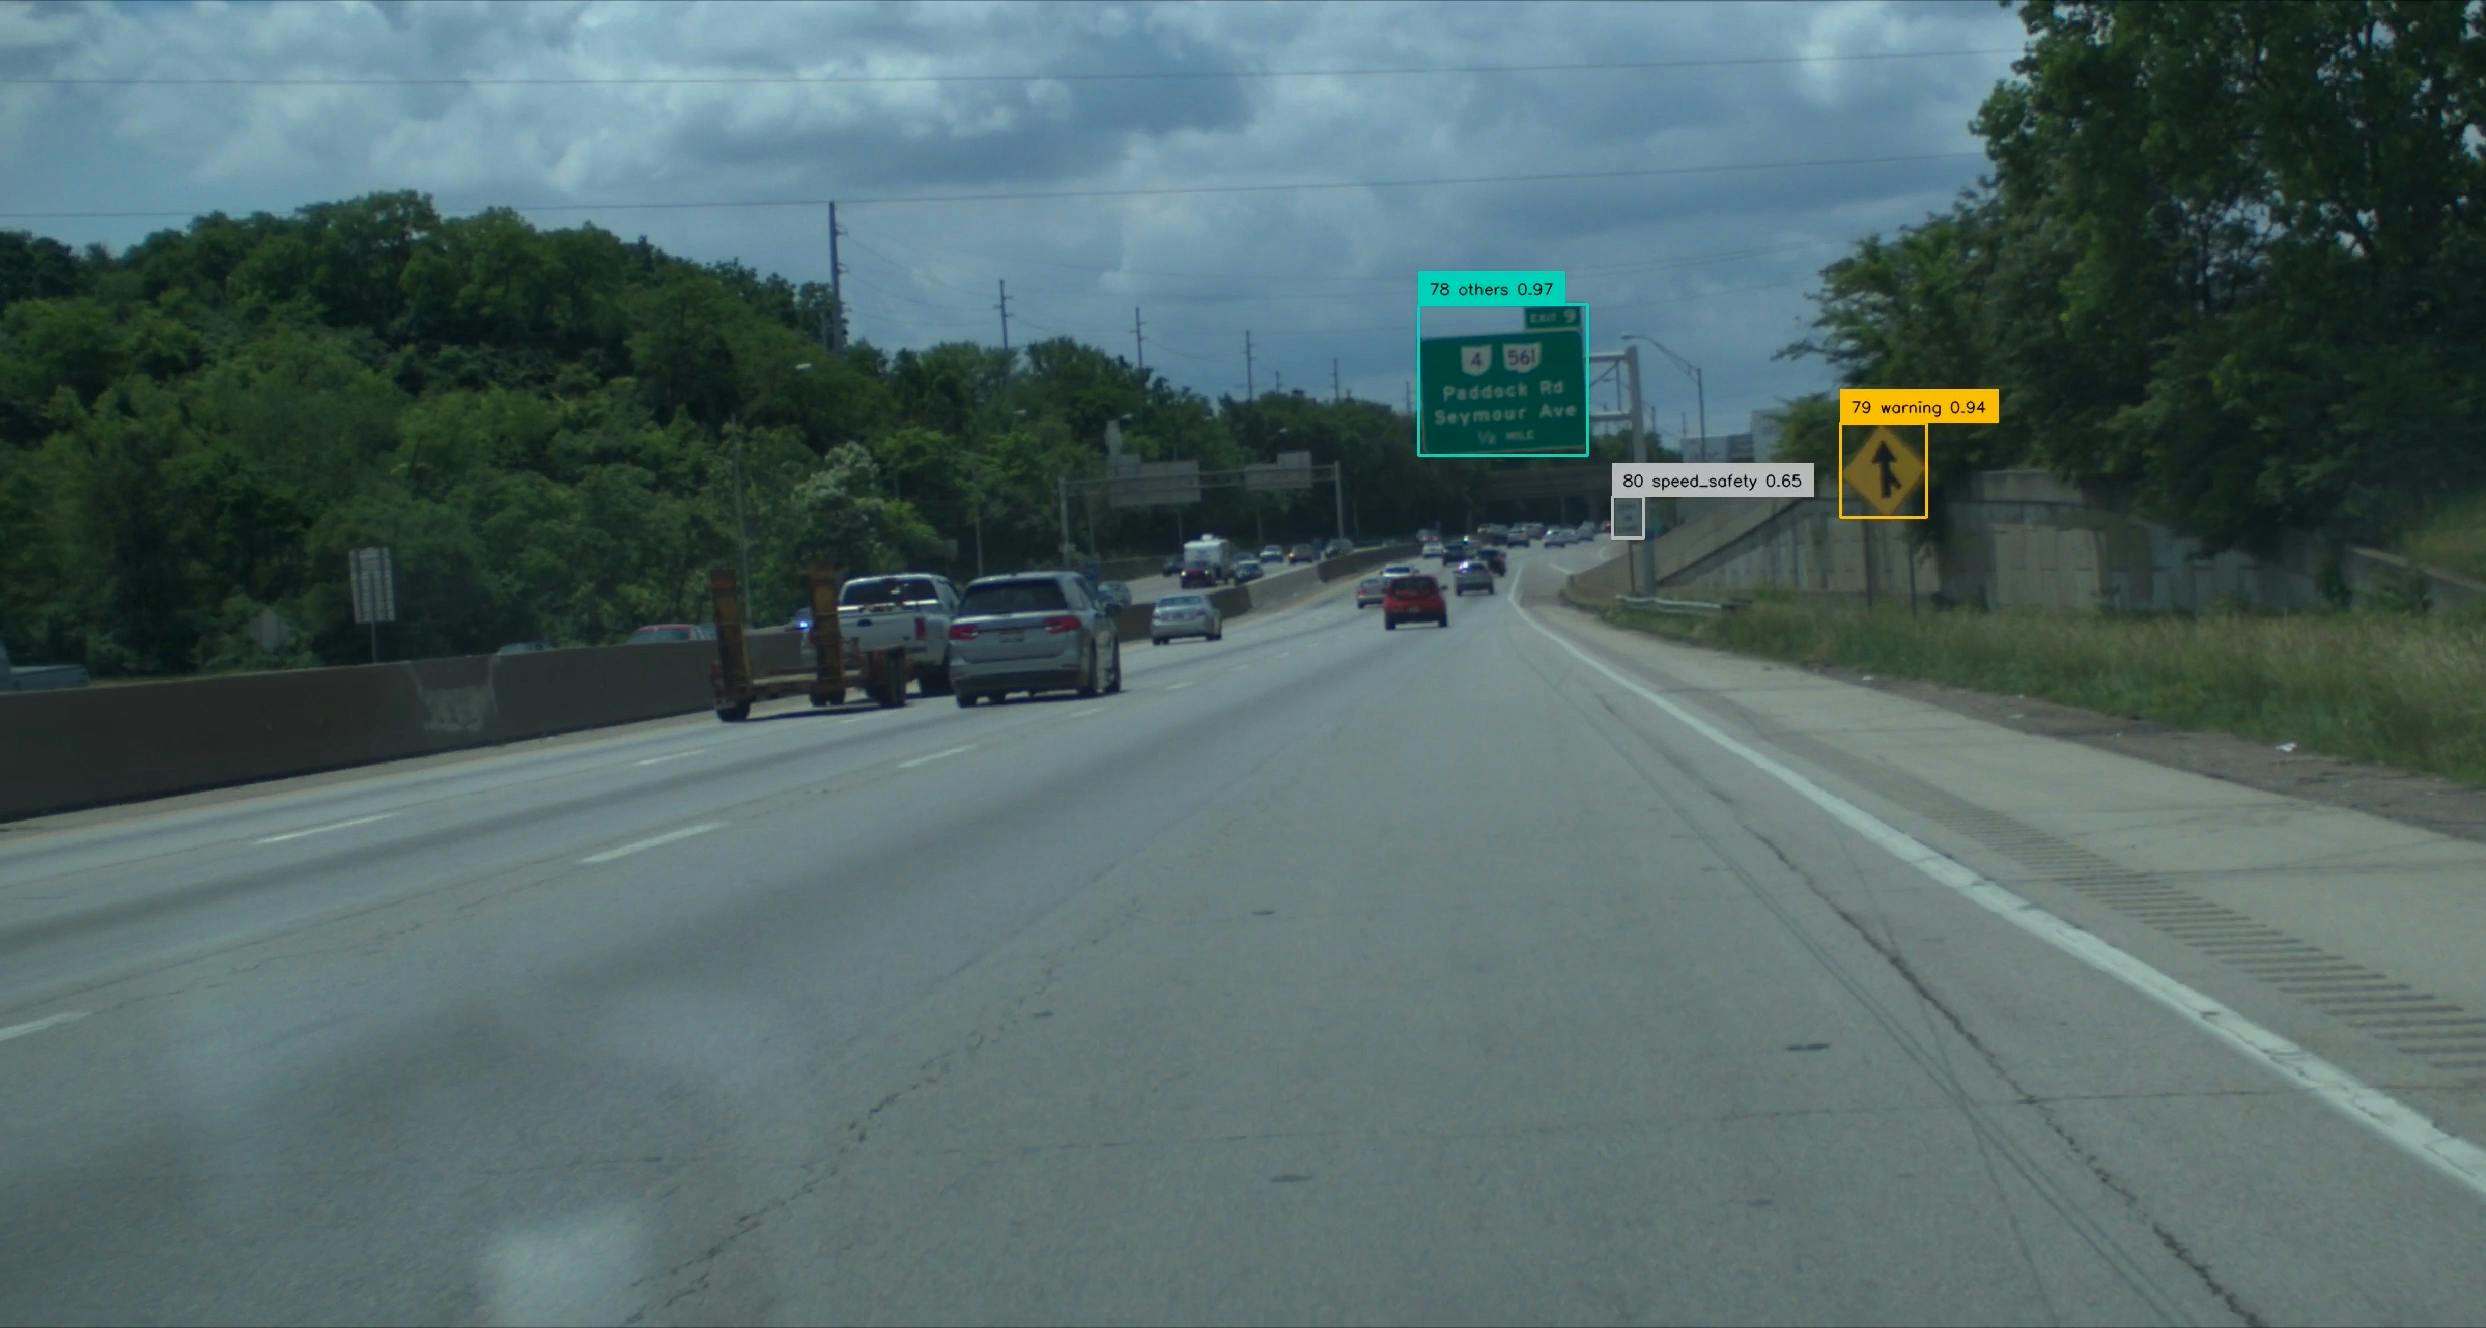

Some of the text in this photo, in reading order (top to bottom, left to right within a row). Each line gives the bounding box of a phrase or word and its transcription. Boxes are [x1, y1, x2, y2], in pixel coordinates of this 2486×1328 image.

[1470, 348, 1536, 369] 4 561
[1442, 380, 1564, 402] Paddock Rd
[1433, 403, 1578, 428] Seymour Ave
